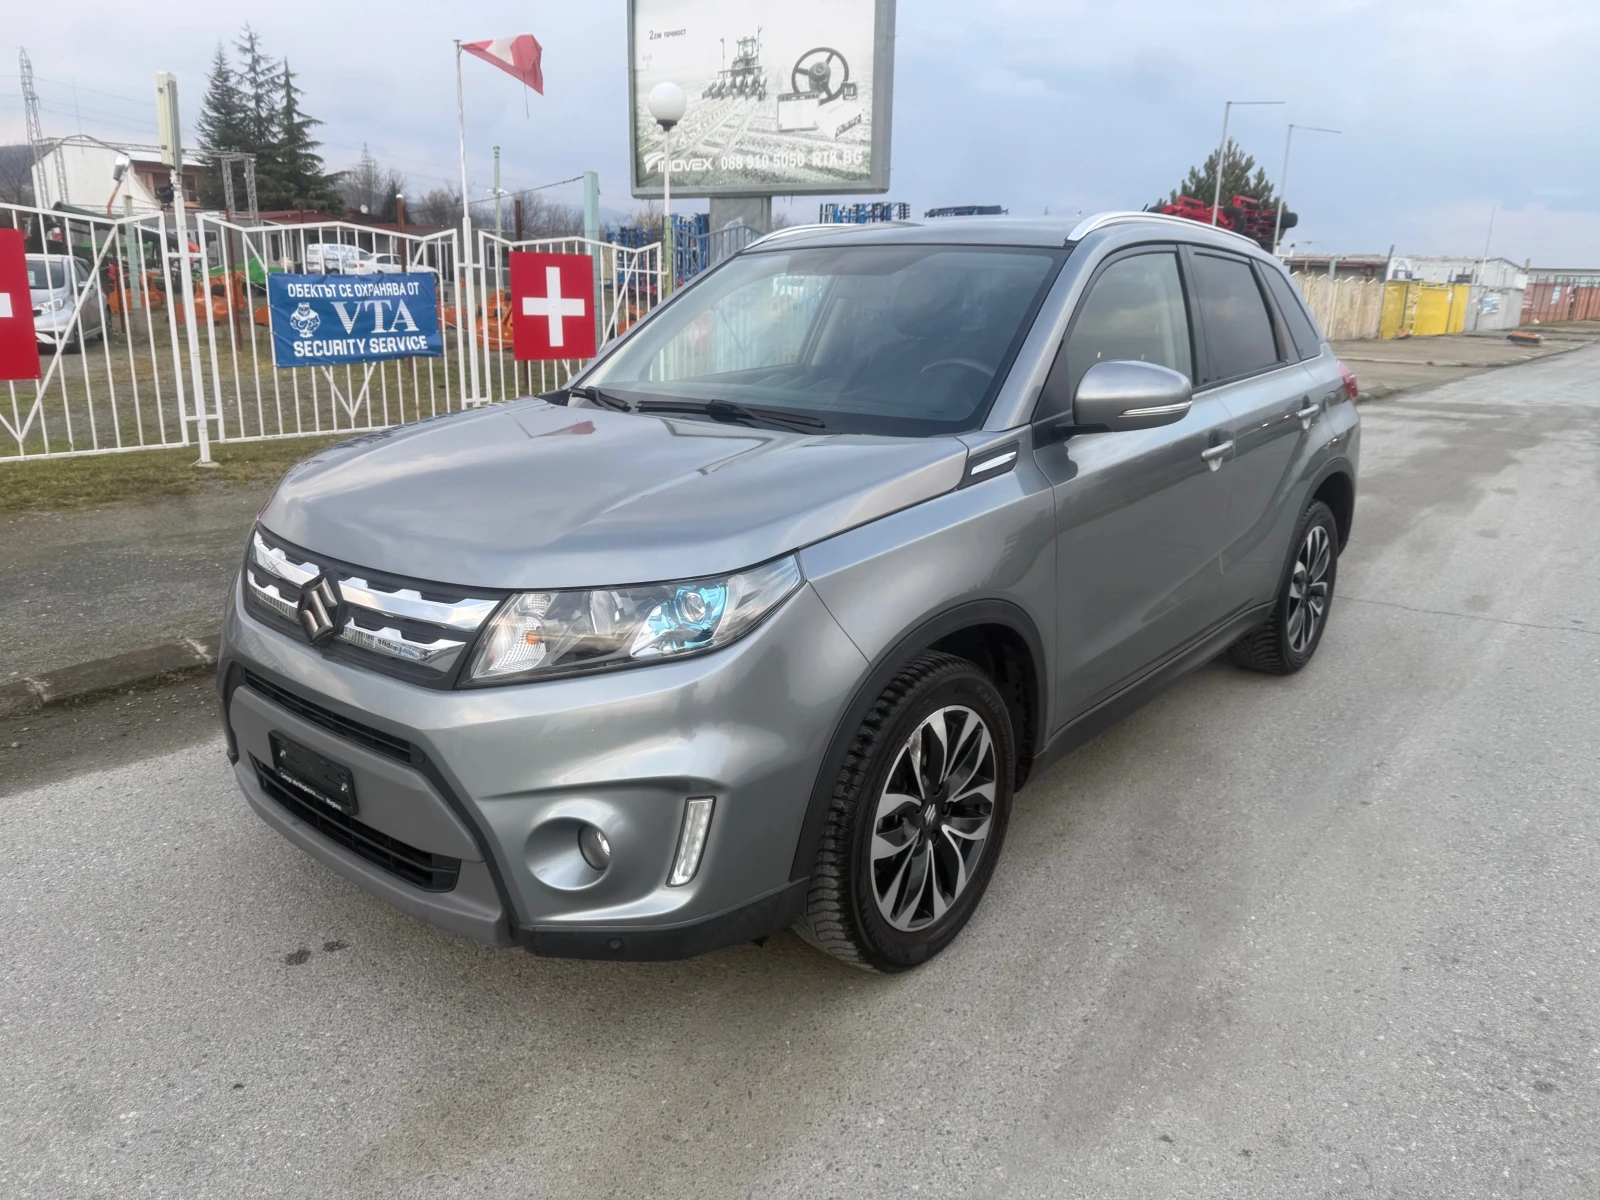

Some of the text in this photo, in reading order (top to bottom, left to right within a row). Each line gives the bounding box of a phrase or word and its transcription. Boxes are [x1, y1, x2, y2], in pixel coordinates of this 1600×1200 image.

[721, 156, 744, 170] 088
[746, 154, 769, 170] 910
[773, 152, 805, 168] 5050
[288, 282, 420, 298] ОБЕКТЪТ СЕ ОХРАНЯВА ОТ
[330, 299, 420, 335] VTA
[293, 335, 428, 357] SECURITY SERVICE
